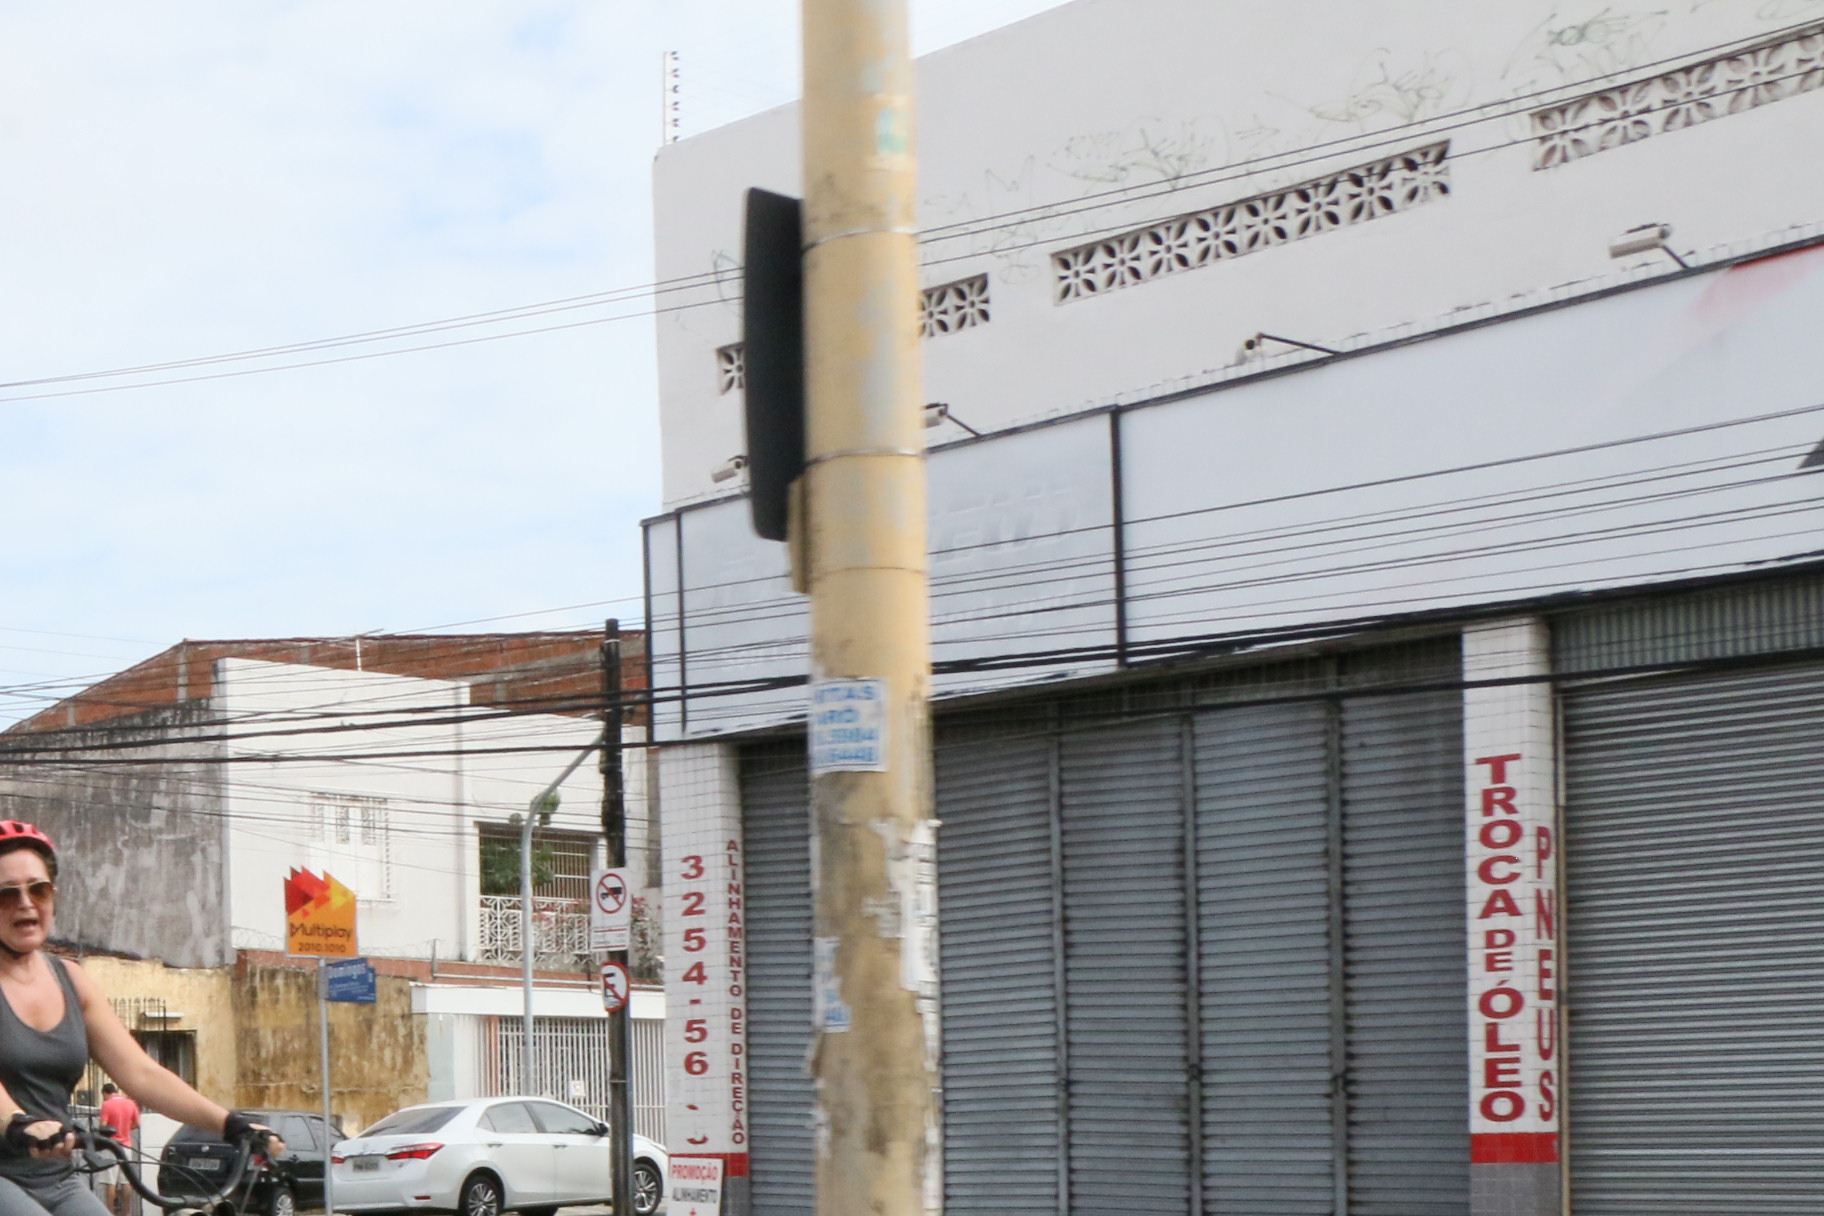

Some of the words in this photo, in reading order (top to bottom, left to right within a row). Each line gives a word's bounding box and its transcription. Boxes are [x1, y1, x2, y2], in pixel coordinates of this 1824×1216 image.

[1475, 753, 1524, 919] TROCA
[289, 922, 352, 941] Multiplay
[726, 839, 743, 998] ALINHAMENTO
[1485, 929, 1516, 972] DE
[730, 1008, 743, 1035] DE
[1536, 826, 1555, 1122] PNEUS
[730, 1043, 745, 1144] DIREÇÃO
[1478, 979, 1525, 1122] ÓLEO
[672, 1162, 717, 1184] PROMOÇÃO
